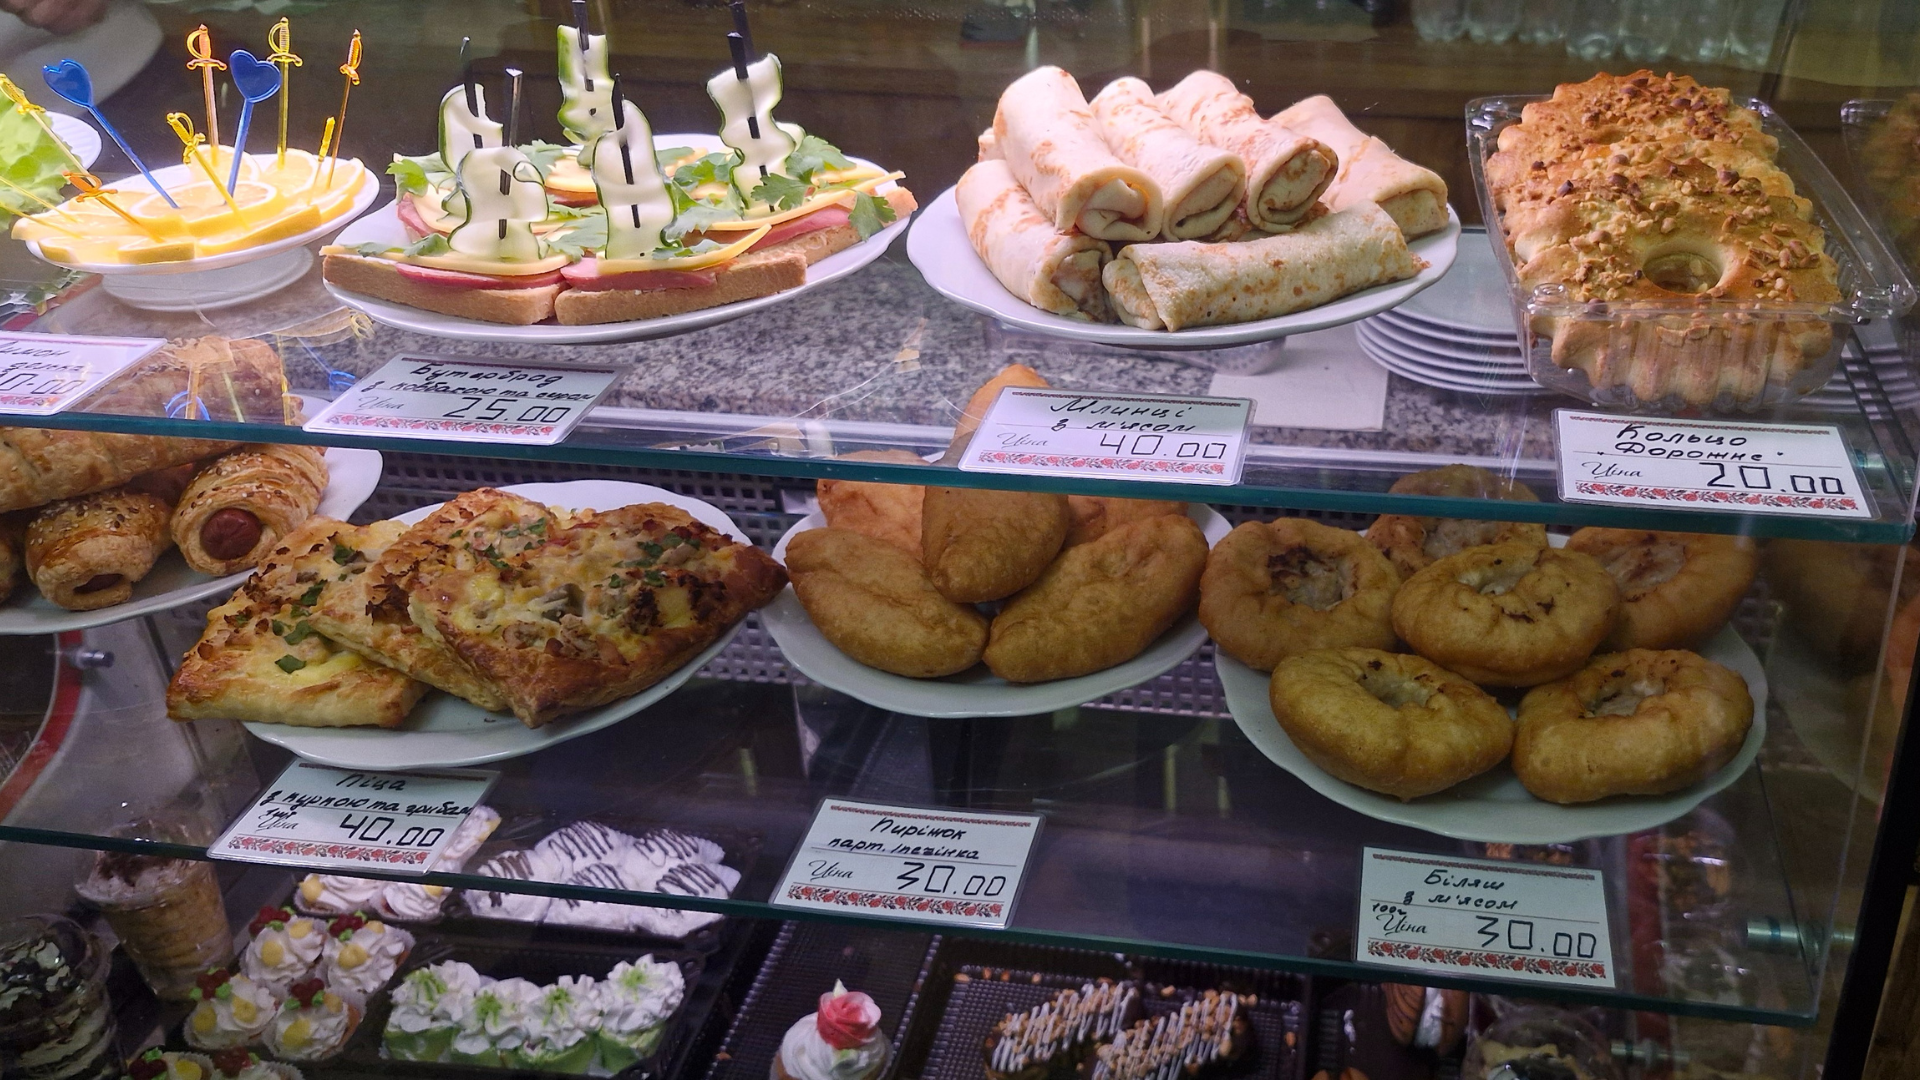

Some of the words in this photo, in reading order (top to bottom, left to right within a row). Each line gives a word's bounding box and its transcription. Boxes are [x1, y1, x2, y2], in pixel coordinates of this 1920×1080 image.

[499, 389, 529, 397] та
[442, 396, 571, 423] 25.00
[1050, 399, 1192, 418] Млинці
[997, 432, 1049, 449] Ціна
[1100, 433, 1228, 460] 40.00
[1616, 423, 1747, 446] Кольцо
[1582, 461, 1644, 479] Ціна
[1699, 462, 1846, 495] 20.00
[339, 813, 445, 847] 40.00
[808, 860, 854, 882] Ціна
[896, 861, 1006, 896] 30.00
[1424, 869, 1505, 891] Біляш
[1375, 913, 1428, 937] Ціна
[1475, 915, 1597, 957] 30.00
